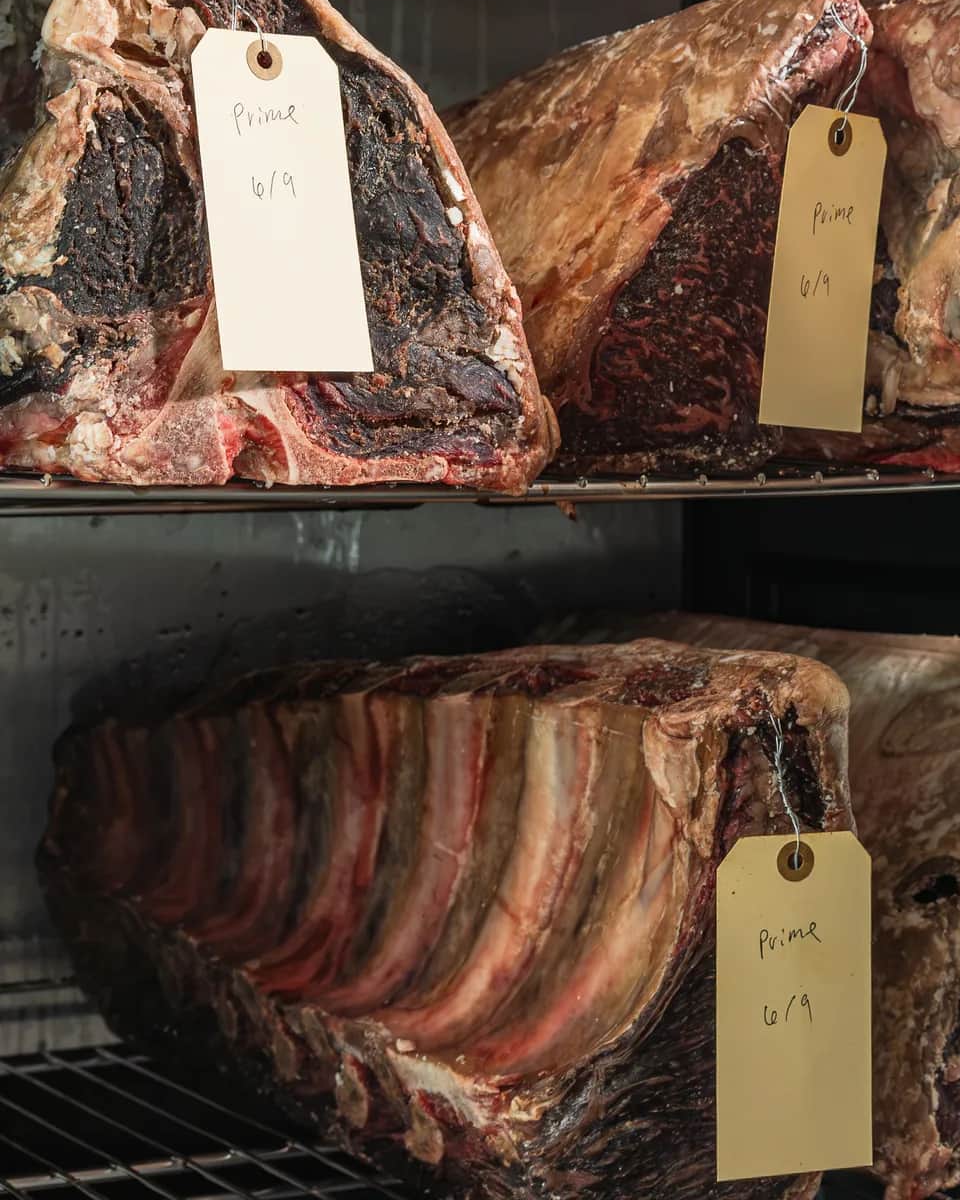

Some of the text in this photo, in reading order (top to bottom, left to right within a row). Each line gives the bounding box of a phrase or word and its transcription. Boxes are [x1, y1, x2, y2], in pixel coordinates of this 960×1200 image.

[233, 102, 299, 136] Prime
[251, 170, 297, 200] 6/9
[813, 202, 854, 235] Prime
[801, 270, 829, 298] 6/9
[764, 993, 813, 1026] 6/9
